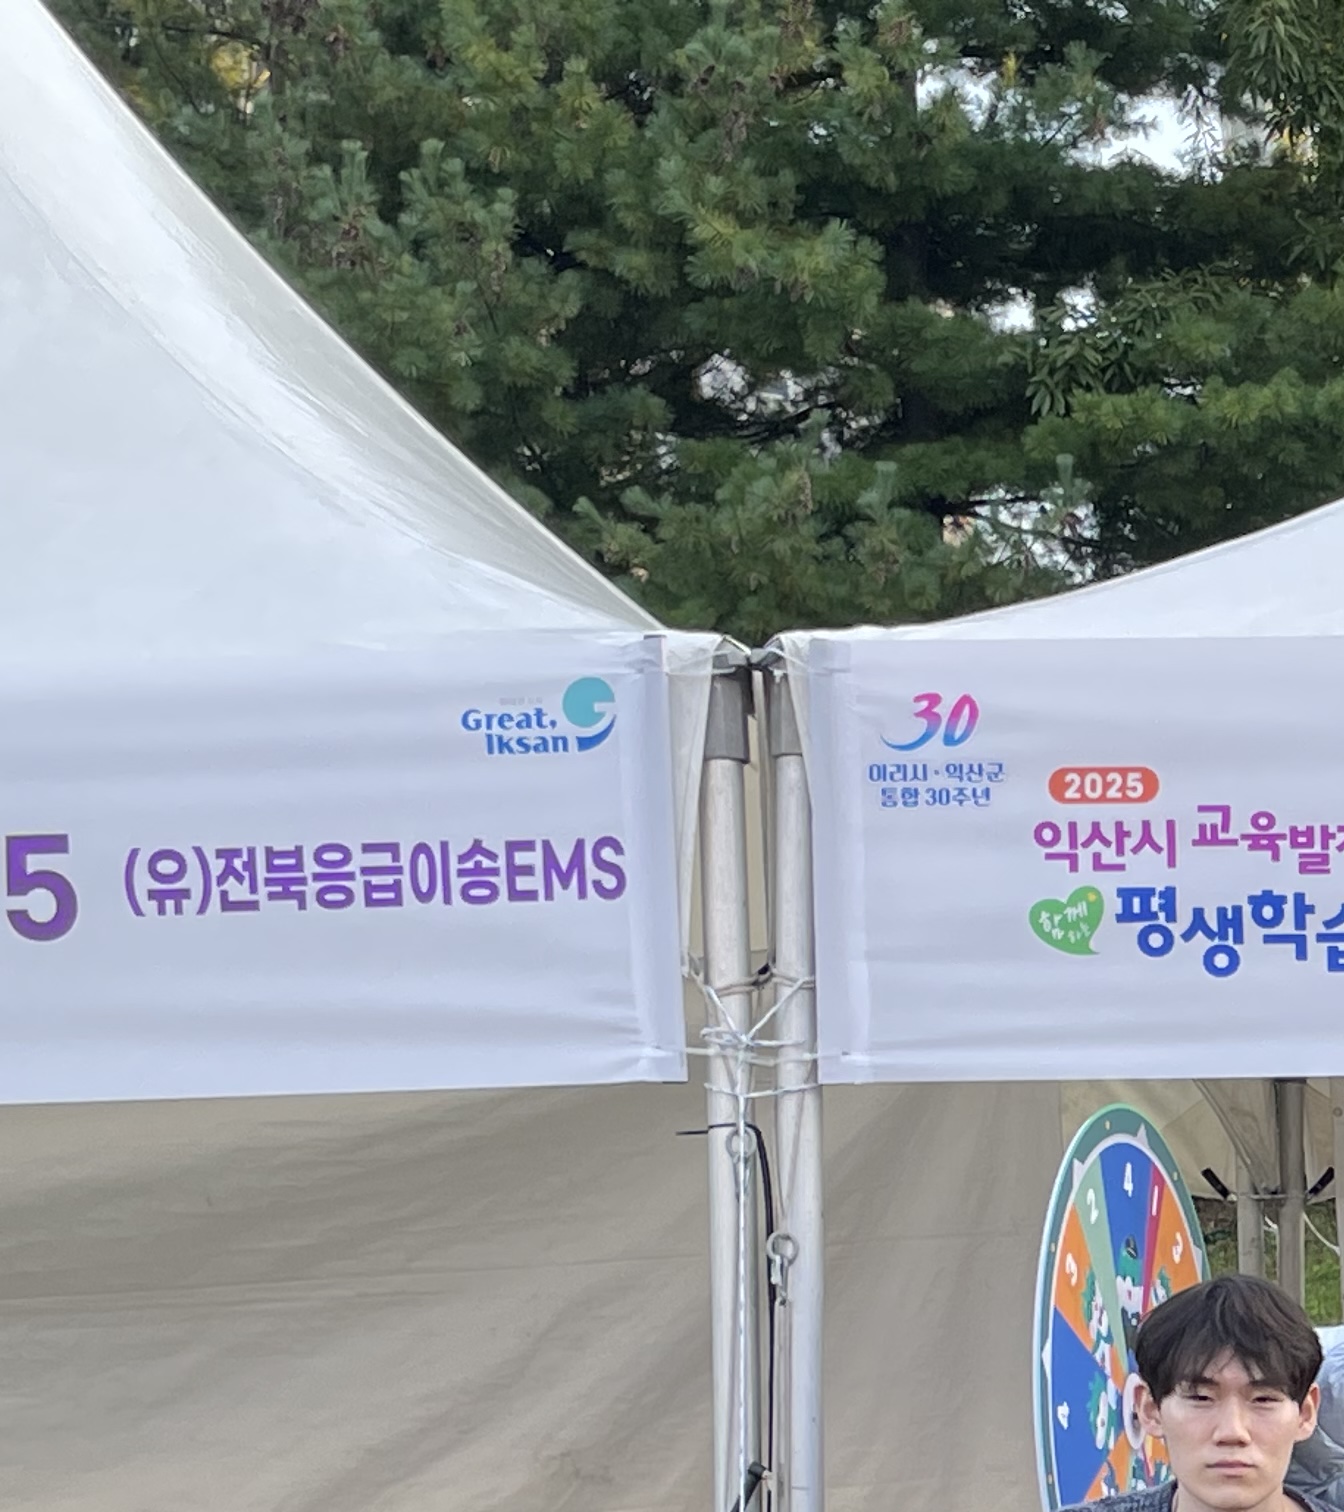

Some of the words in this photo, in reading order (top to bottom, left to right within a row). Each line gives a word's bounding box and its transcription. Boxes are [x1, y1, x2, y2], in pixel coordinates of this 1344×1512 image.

[461, 708, 557, 731] Great,
[880, 692, 979, 751] 30
[485, 733, 569, 755] Iksan
[881, 787, 919, 808] 통합
[925, 787, 991, 807] 30주년
[1063, 773, 1144, 800] 2025
[1033, 819, 1178, 873] 익산시
[5, 833, 78, 942] 5
[124, 836, 627, 916] (유)전북응급이송EMS
[1123, 1162, 1134, 1198] 4
[1086, 1188, 1099, 1225] 2
